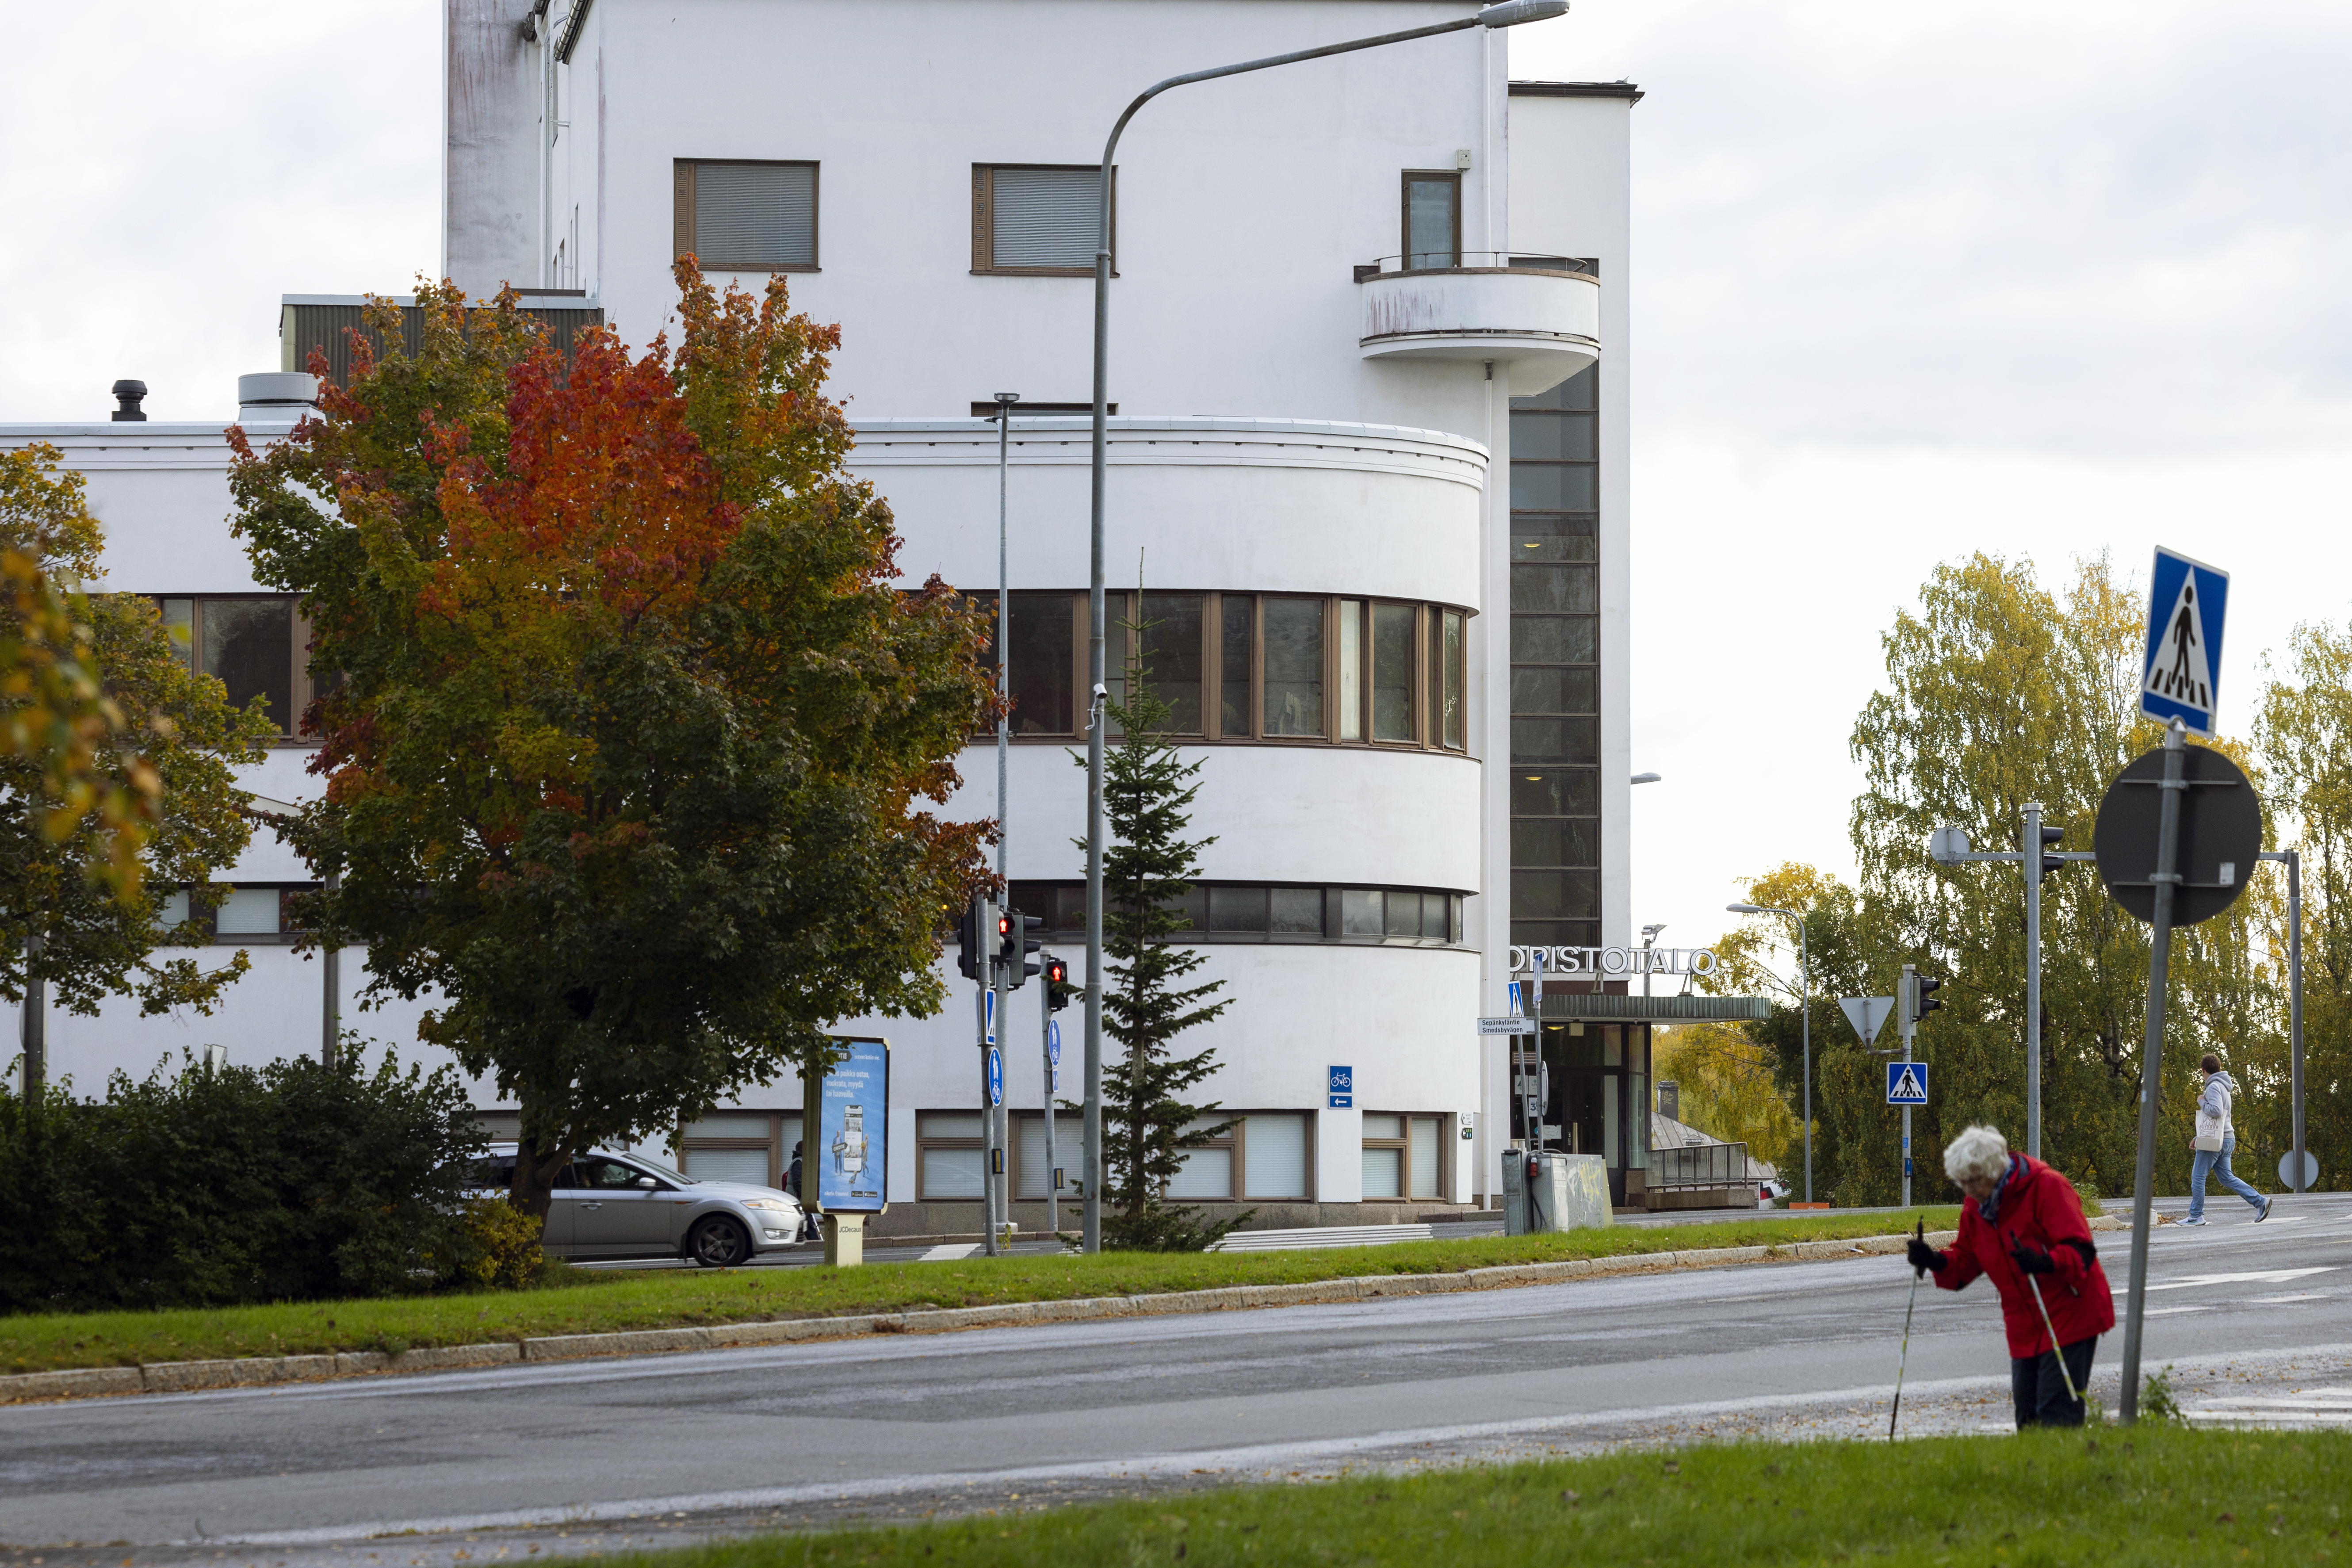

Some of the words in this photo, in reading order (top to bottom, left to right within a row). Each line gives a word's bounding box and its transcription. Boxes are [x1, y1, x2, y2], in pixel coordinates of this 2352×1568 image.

[1510, 945, 1717, 975] OPISTOTALO
[840, 1070, 855, 1078] paikka
[826, 1079, 847, 1088] vuokrata,
[848, 1080, 864, 1089] myydä
